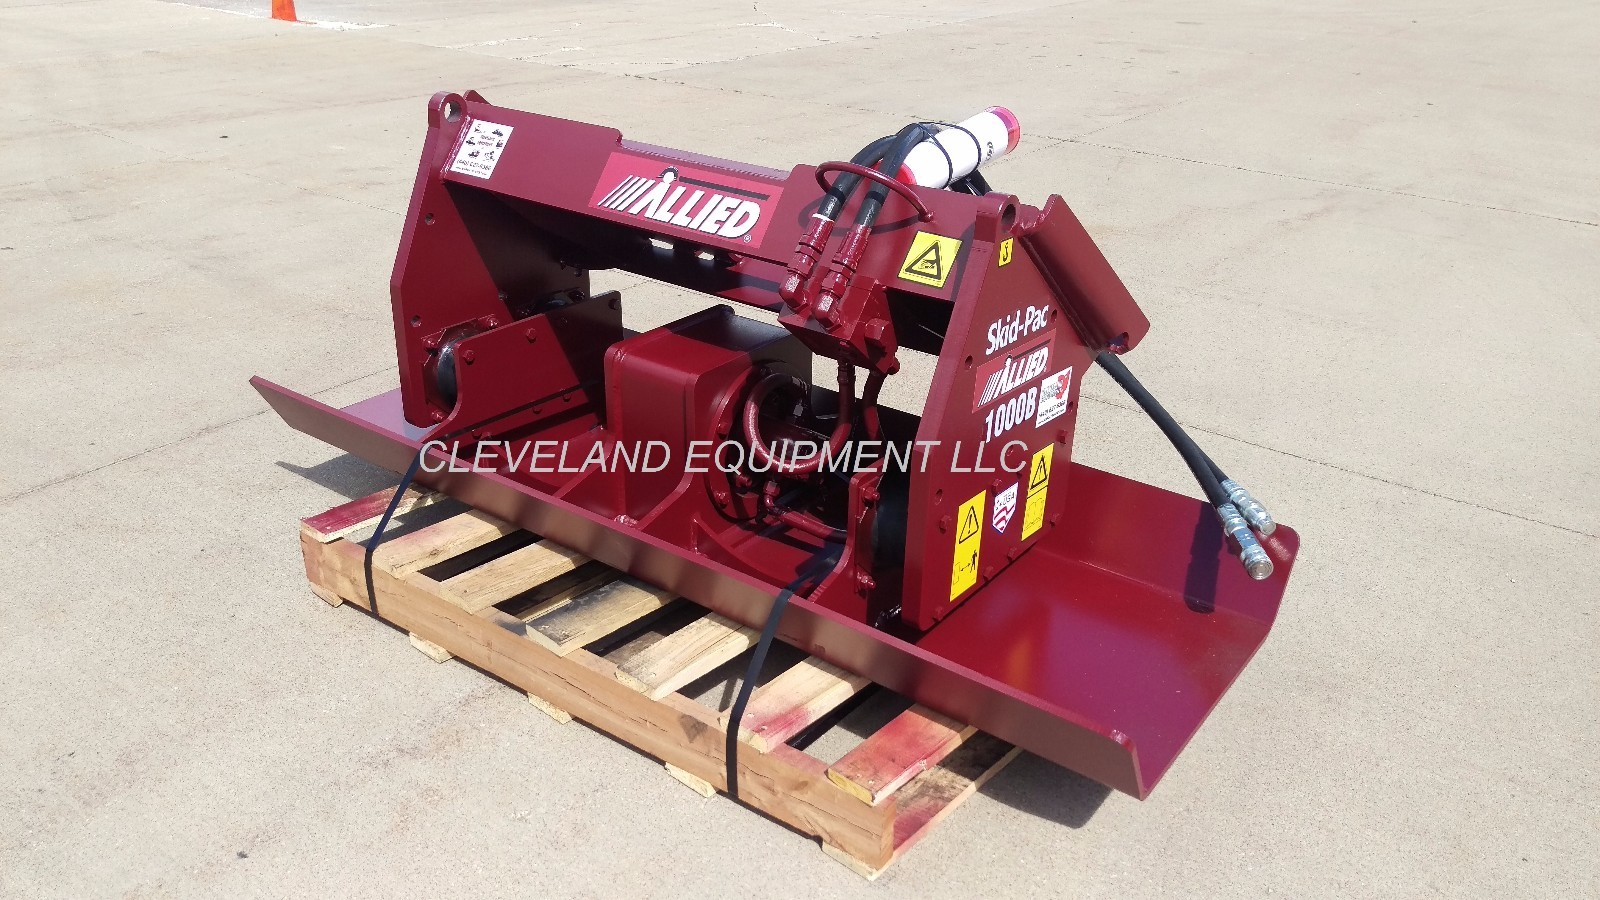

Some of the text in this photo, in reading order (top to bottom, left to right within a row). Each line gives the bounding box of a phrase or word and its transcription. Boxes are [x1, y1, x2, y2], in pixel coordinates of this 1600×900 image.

[628, 171, 761, 240] ALLIED
[985, 304, 1050, 356] Skid-Pac
[993, 346, 1050, 398] ALLIED
[985, 385, 1038, 444] 1000B
